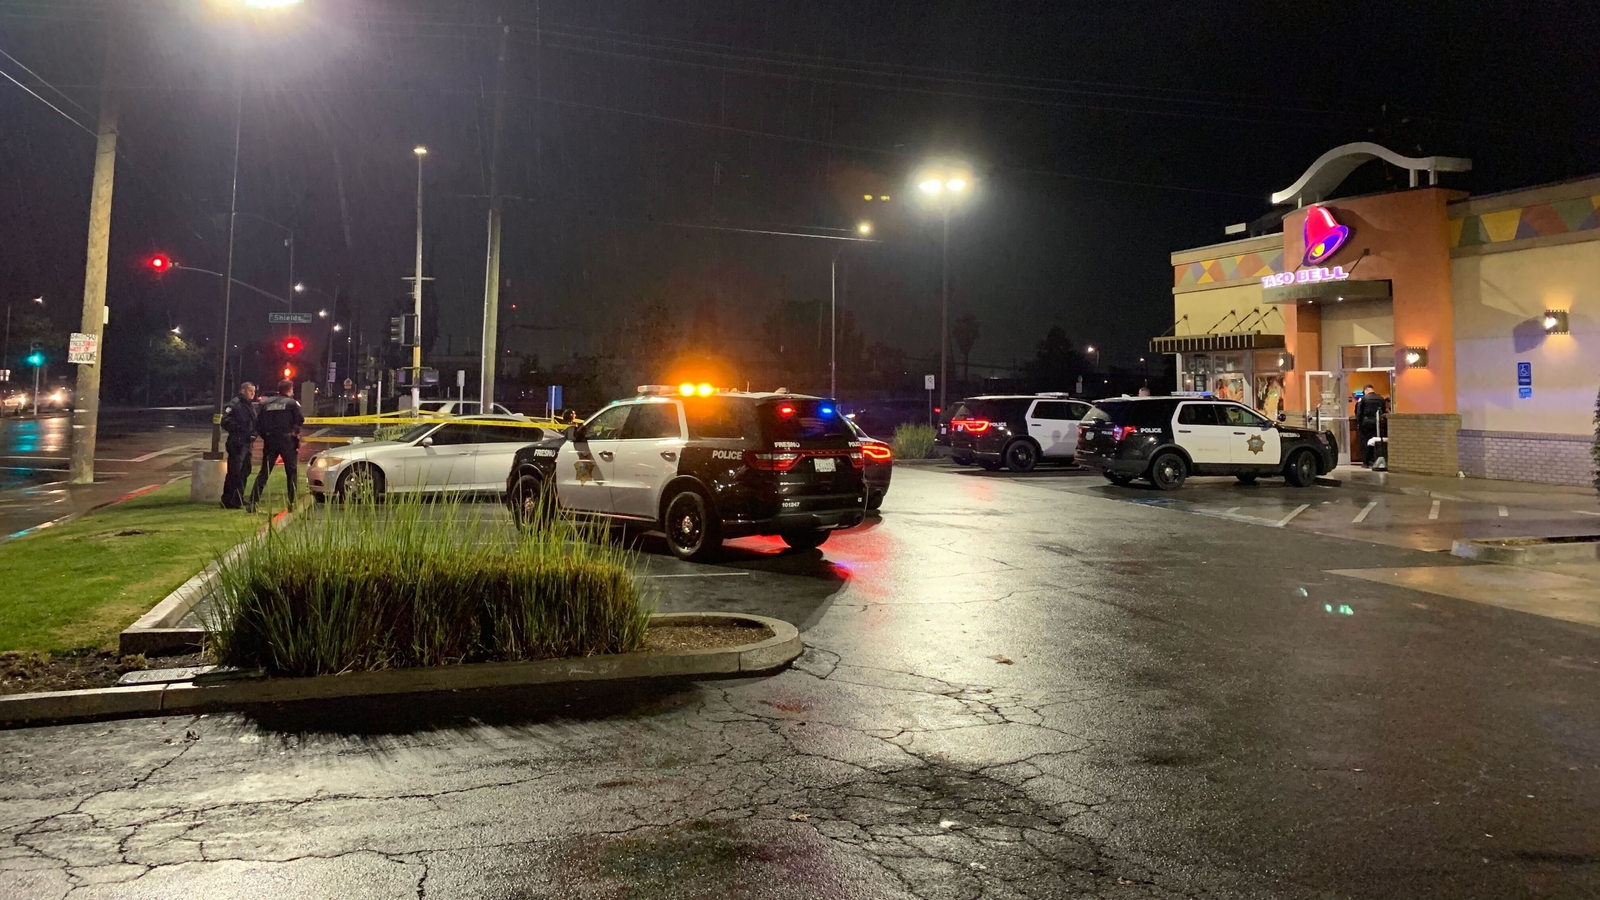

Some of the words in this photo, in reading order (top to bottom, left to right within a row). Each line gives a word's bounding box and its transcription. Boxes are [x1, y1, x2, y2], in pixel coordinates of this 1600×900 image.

[1261, 272, 1295, 288] TACO
[1296, 265, 1350, 283] BELL
[533, 449, 556, 457] FRESNO
[712, 450, 743, 460] POLICE
